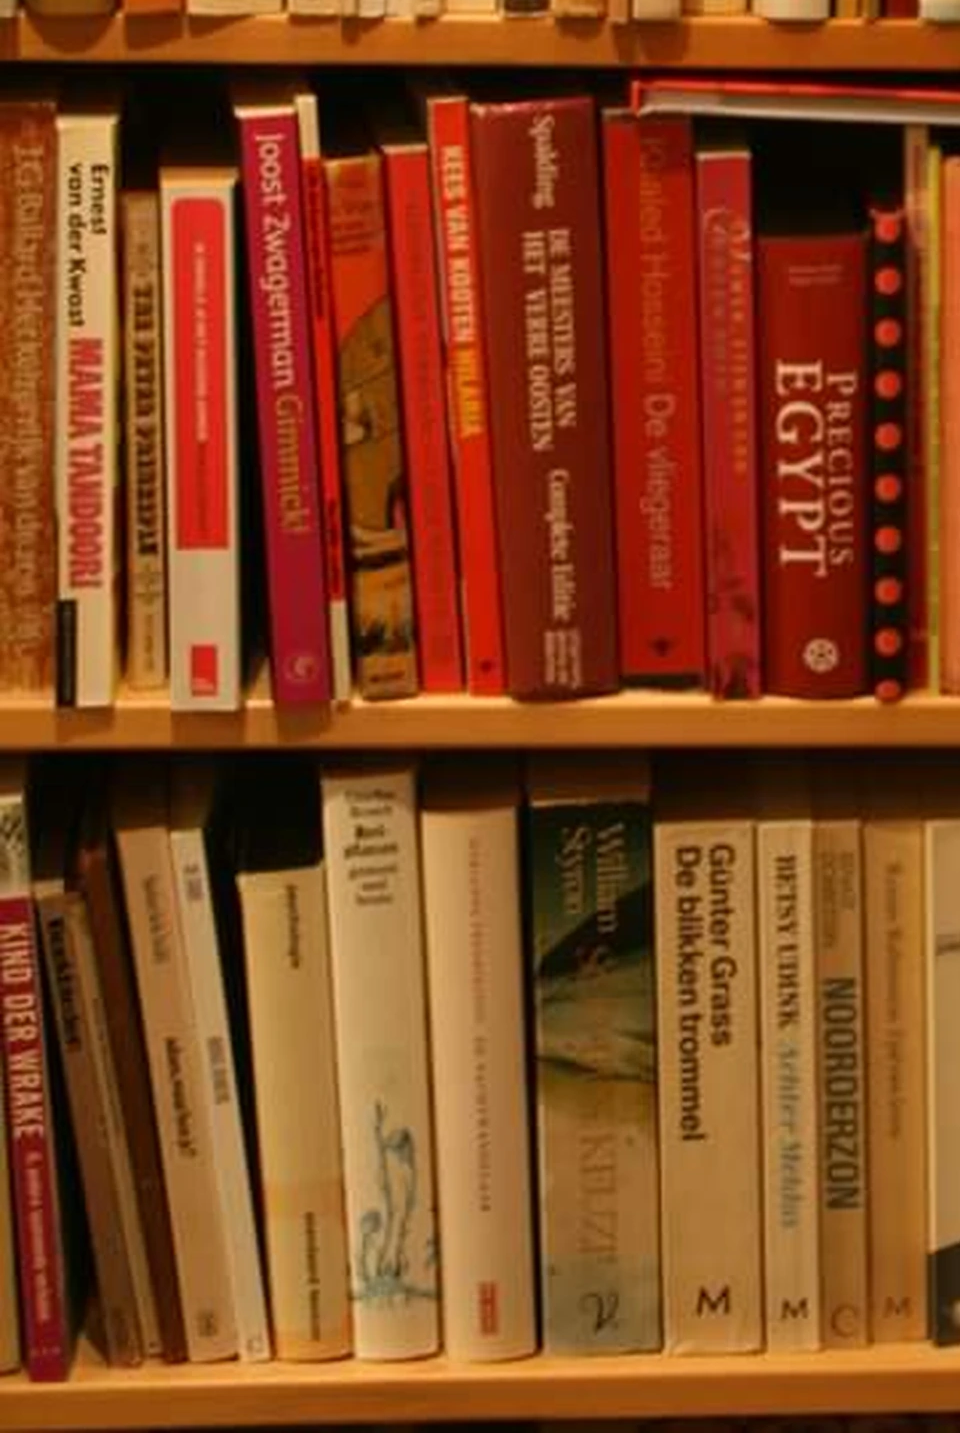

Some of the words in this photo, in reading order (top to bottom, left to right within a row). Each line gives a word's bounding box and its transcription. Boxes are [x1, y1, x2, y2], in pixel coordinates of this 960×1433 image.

[68, 164, 85, 205] van
[91, 165, 108, 234] Ernest
[254, 134, 285, 206] Joost
[442, 146, 465, 199] KEES
[529, 115, 558, 209] Spalding
[68, 213, 87, 249] der
[446, 205, 466, 249] VAN
[522, 233, 545, 274] HET
[549, 229, 570, 257] DE
[68, 259, 85, 326] Kwast
[260, 214, 296, 389] Zwagerman
[449, 257, 472, 342] KOOTEN
[525, 291, 547, 357] VERRE
[550, 265, 574, 375] MEESTERS
[68, 339, 102, 436] MAMA
[529, 365, 551, 450] OOSTEN
[555, 384, 575, 427] VAN
[646, 393, 674, 435] De
[776, 359, 823, 578] EGYPT
[70, 445, 103, 588] TANDOORI
[642, 450, 677, 588] vliegeraar
[596, 825, 625, 934] William
[676, 848, 701, 888] De
[707, 845, 734, 946] Günter
[775, 855, 798, 935] BETSY
[1, 923, 36, 986] KIND
[676, 897, 702, 1005] blikken
[777, 942, 800, 1028] UDINK
[5, 995, 40, 1041] DER
[710, 957, 735, 1047] Grass
[11, 1051, 45, 1140] WRAKE
[680, 1014, 704, 1140] trommel
[822, 977, 858, 1211] NOORDERZON
